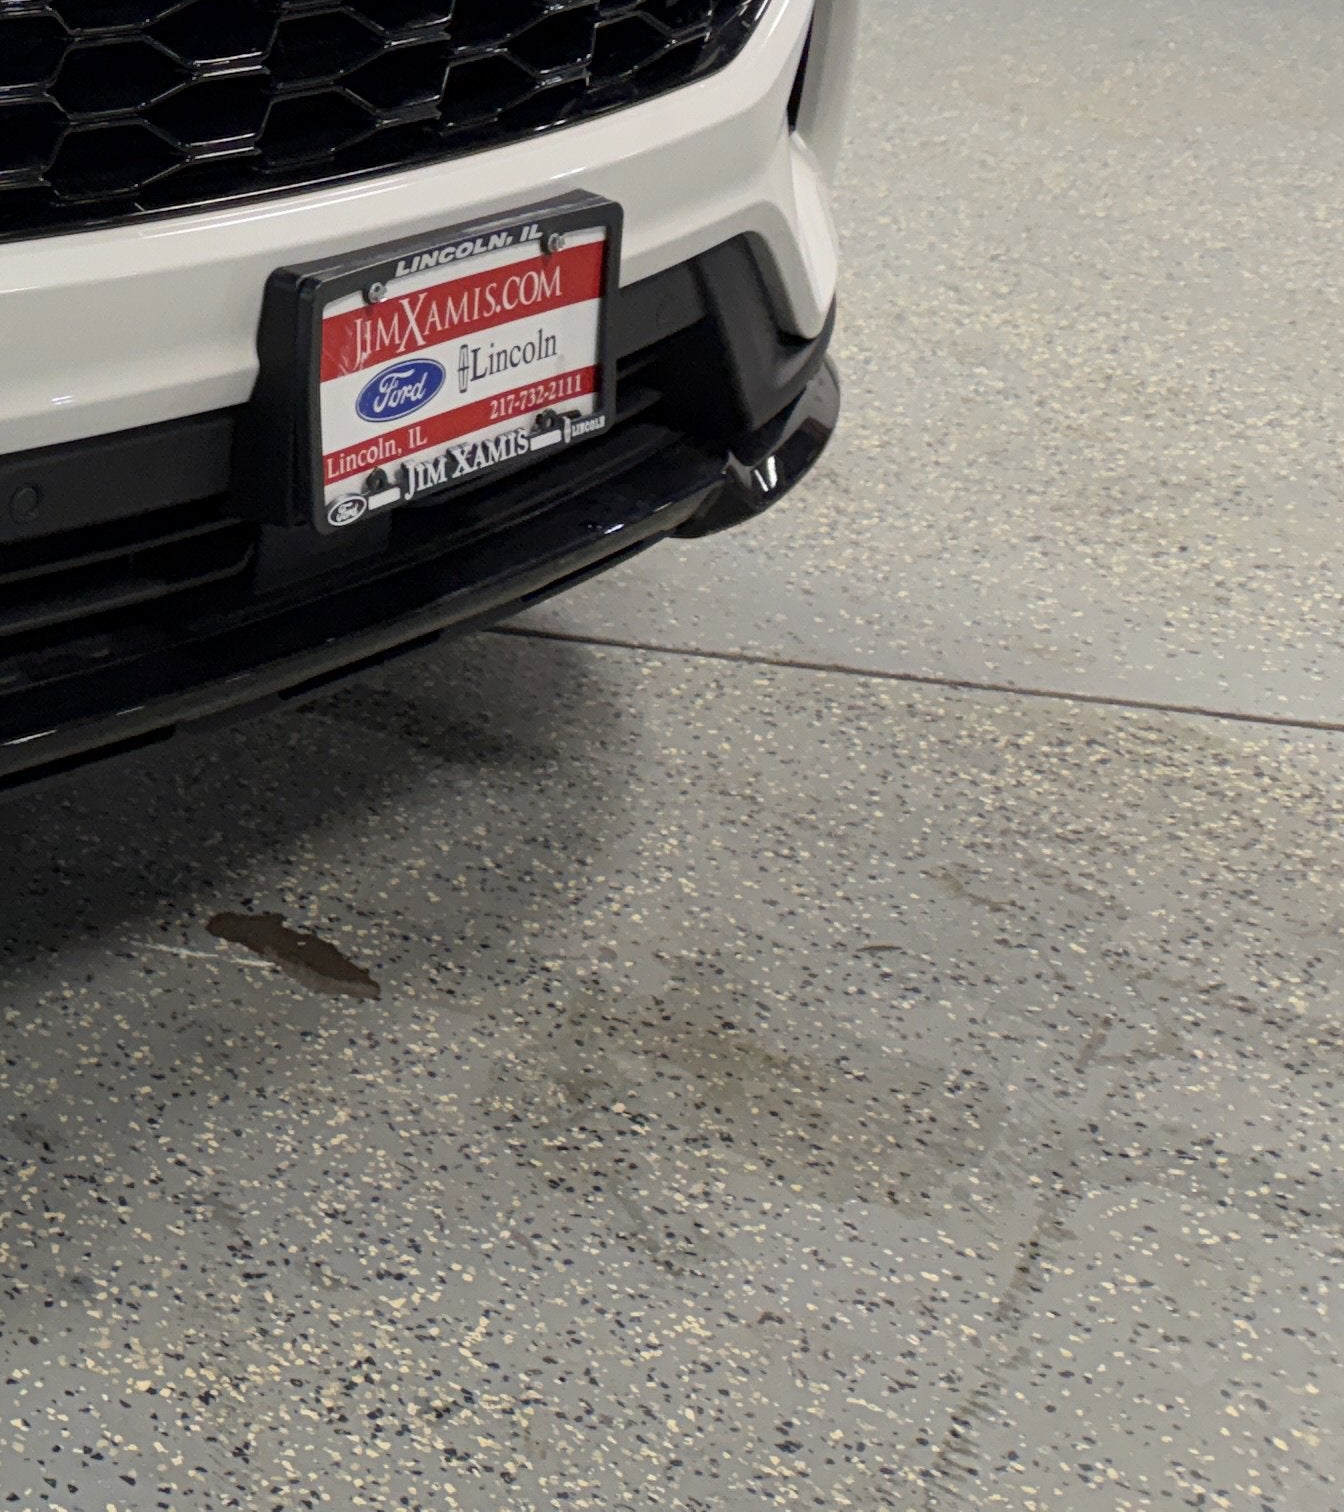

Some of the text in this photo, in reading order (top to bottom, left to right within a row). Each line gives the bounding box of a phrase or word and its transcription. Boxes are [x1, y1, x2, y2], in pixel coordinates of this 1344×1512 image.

[394, 223, 543, 279] LINCOLN, IL
[470, 328, 558, 382] Lincoln
[372, 368, 429, 413] Ford
[489, 374, 582, 420] 217-732-2111
[326, 425, 428, 479] Lincoln, IL
[403, 429, 530, 501] JIM XAMIS
